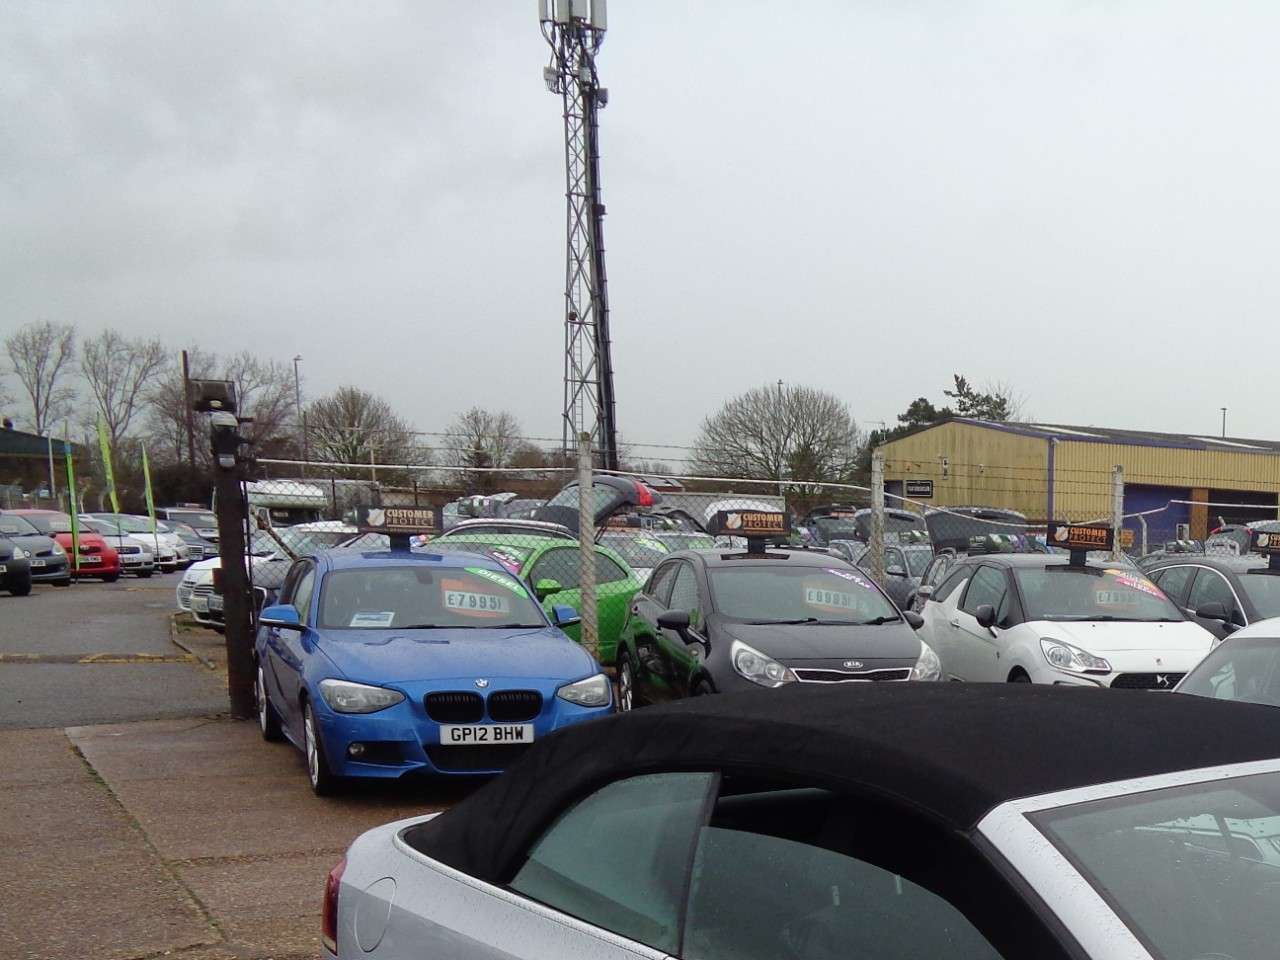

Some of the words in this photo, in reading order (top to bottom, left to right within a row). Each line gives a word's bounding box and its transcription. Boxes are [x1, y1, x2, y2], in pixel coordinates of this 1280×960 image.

[386, 509, 434, 519] CUSTOMER
[743, 513, 783, 521] CUSTOMER
[386, 518, 434, 526] PROTECT
[1070, 527, 1107, 536] CUSTOMER
[478, 569, 519, 591] DIESEL
[451, 726, 488, 742] GP12
[493, 725, 524, 741] BHW
